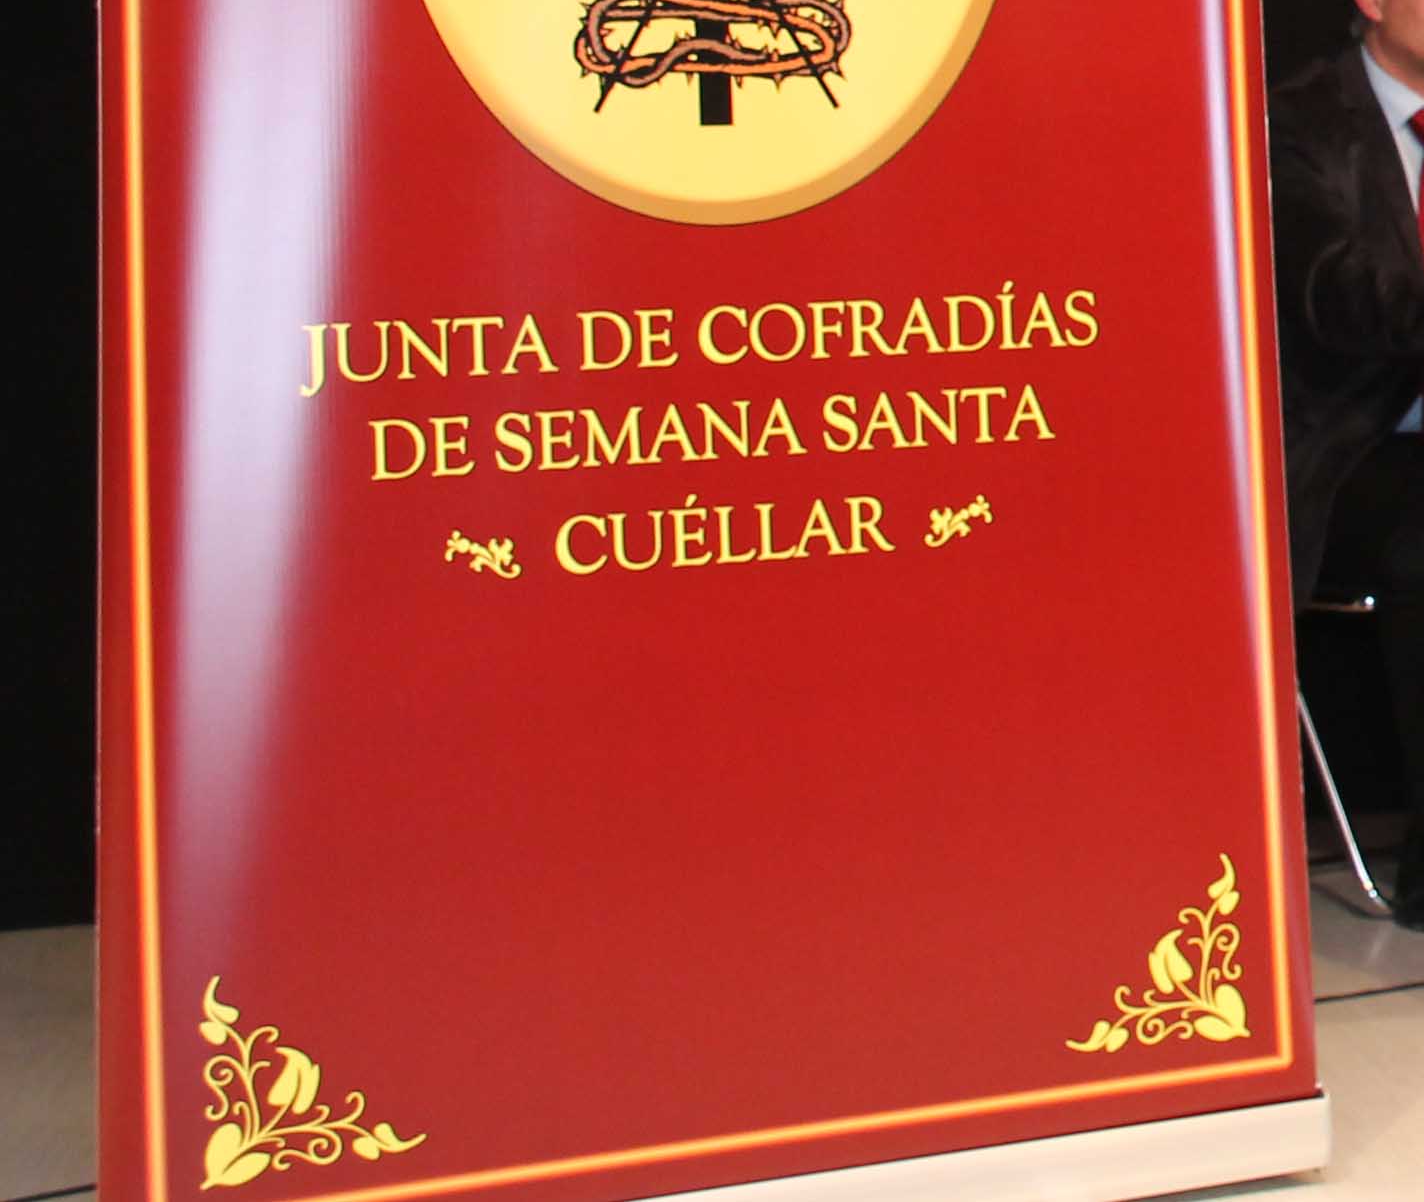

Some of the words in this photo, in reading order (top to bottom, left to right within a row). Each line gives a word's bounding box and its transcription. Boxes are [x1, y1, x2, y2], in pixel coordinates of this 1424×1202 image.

[298, 312, 558, 398] JUNTA
[578, 308, 680, 372] DE
[696, 280, 1100, 366] COFRADÍAS
[369, 416, 476, 481] DE
[493, 397, 808, 476] SEMANA
[820, 383, 1056, 454] SANTA
[553, 492, 896, 577] CUÉLLAR
